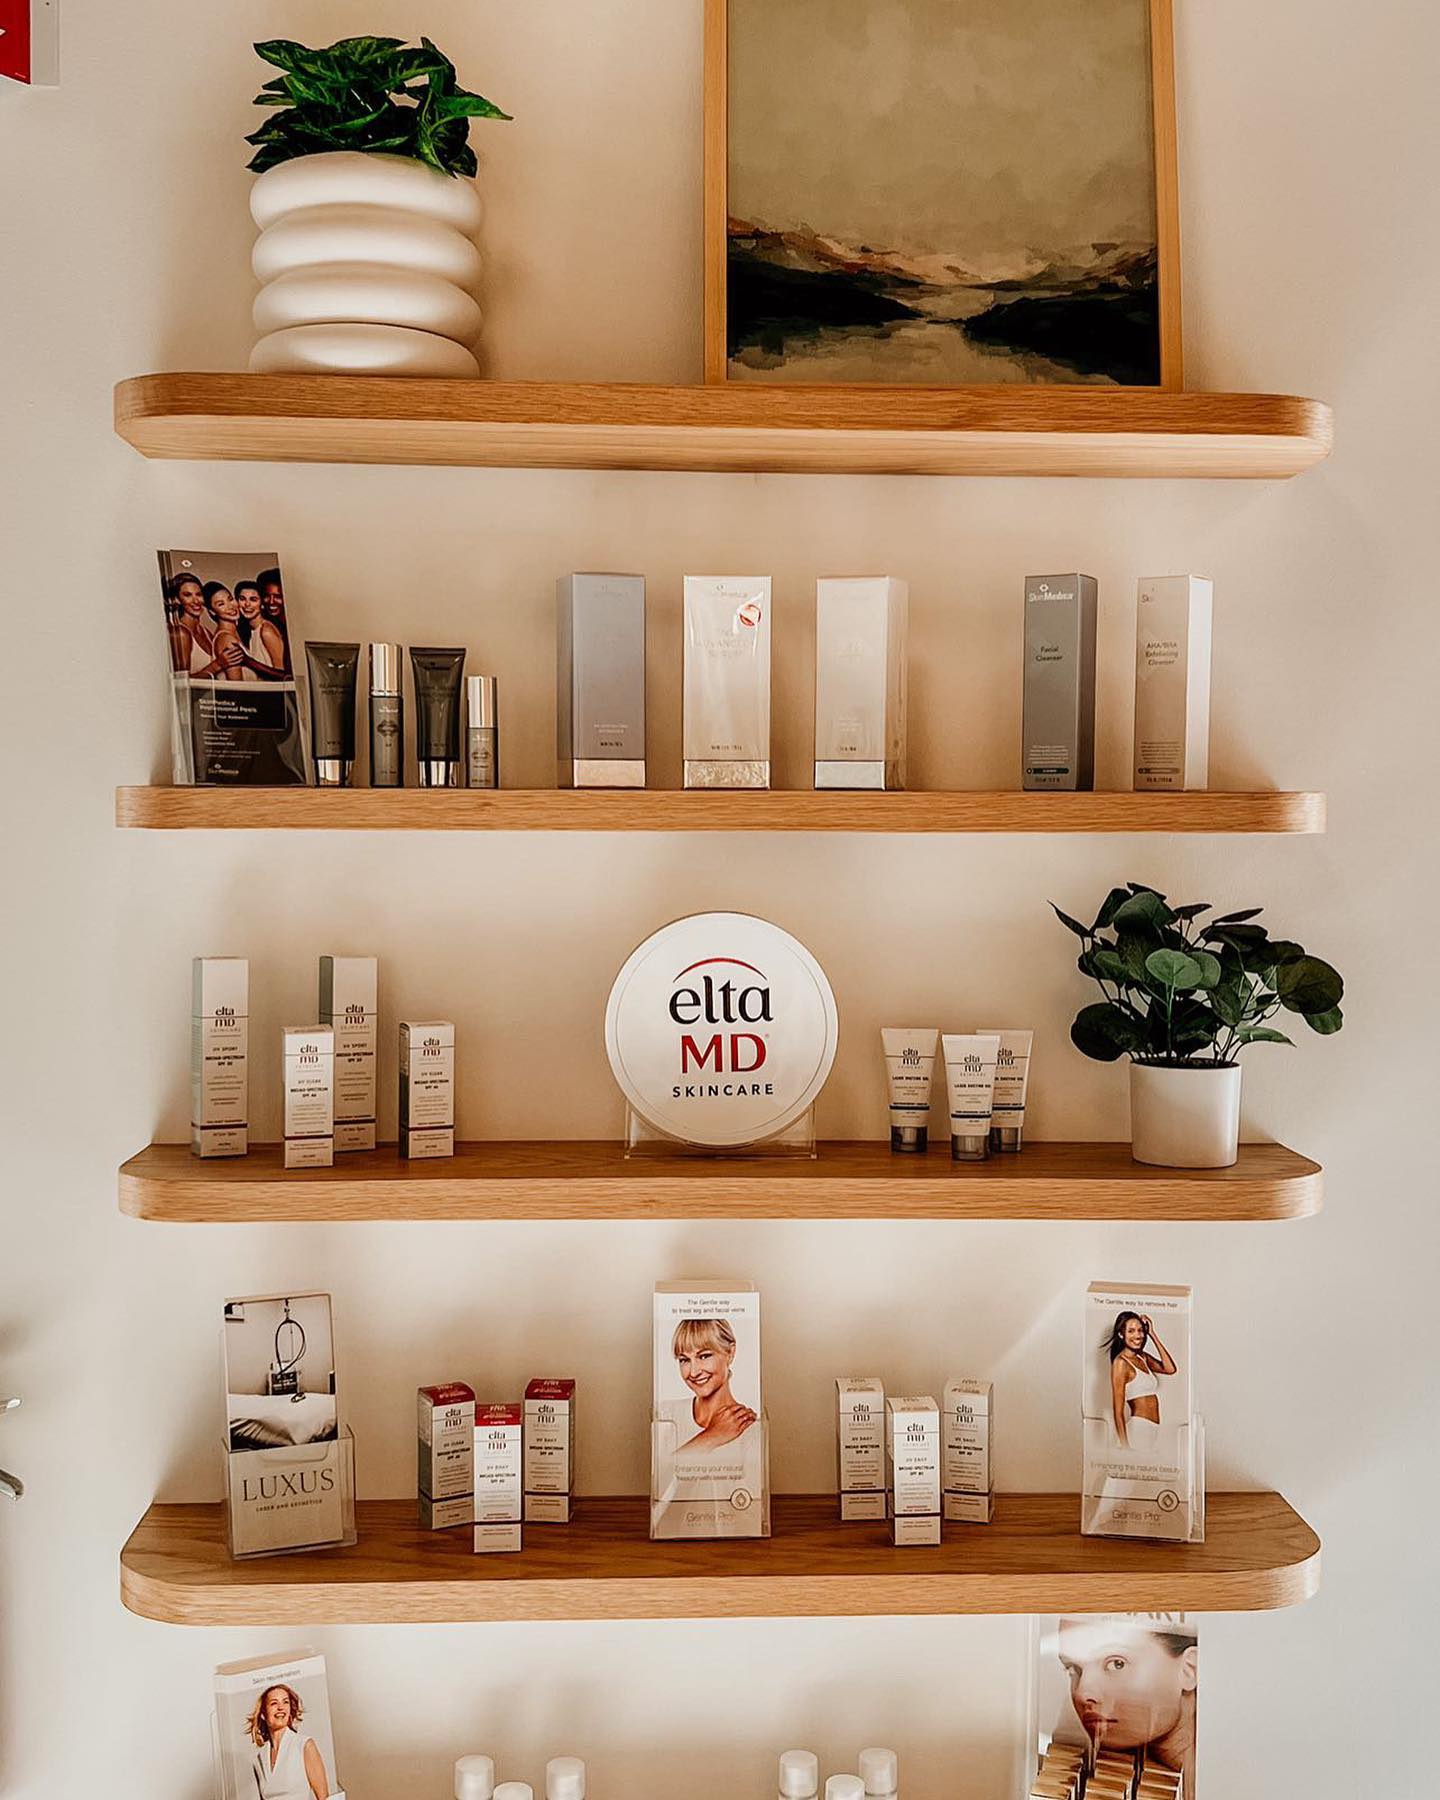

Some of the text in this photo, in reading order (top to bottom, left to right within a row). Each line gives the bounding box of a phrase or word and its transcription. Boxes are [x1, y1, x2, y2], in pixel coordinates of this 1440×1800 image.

[669, 976, 774, 1024] elta
[216, 1006, 234, 1016] elta
[346, 1004, 364, 1014] elta
[423, 1038, 440, 1046] elta
[300, 1044, 318, 1053] elta
[903, 1048, 918, 1056] elta
[997, 1048, 1012, 1057] elta
[681, 1033, 768, 1074] MD
[964, 1054, 980, 1063] elta
[672, 1084, 774, 1098] SKINCARE
[538, 1404, 554, 1413] elta
[853, 1403, 869, 1412] elta
[956, 1404, 972, 1413] elta
[446, 1408, 461, 1417] elta
[907, 1423, 924, 1432] elta
[489, 1431, 506, 1439] elta
[243, 1468, 334, 1501] LUXUS
